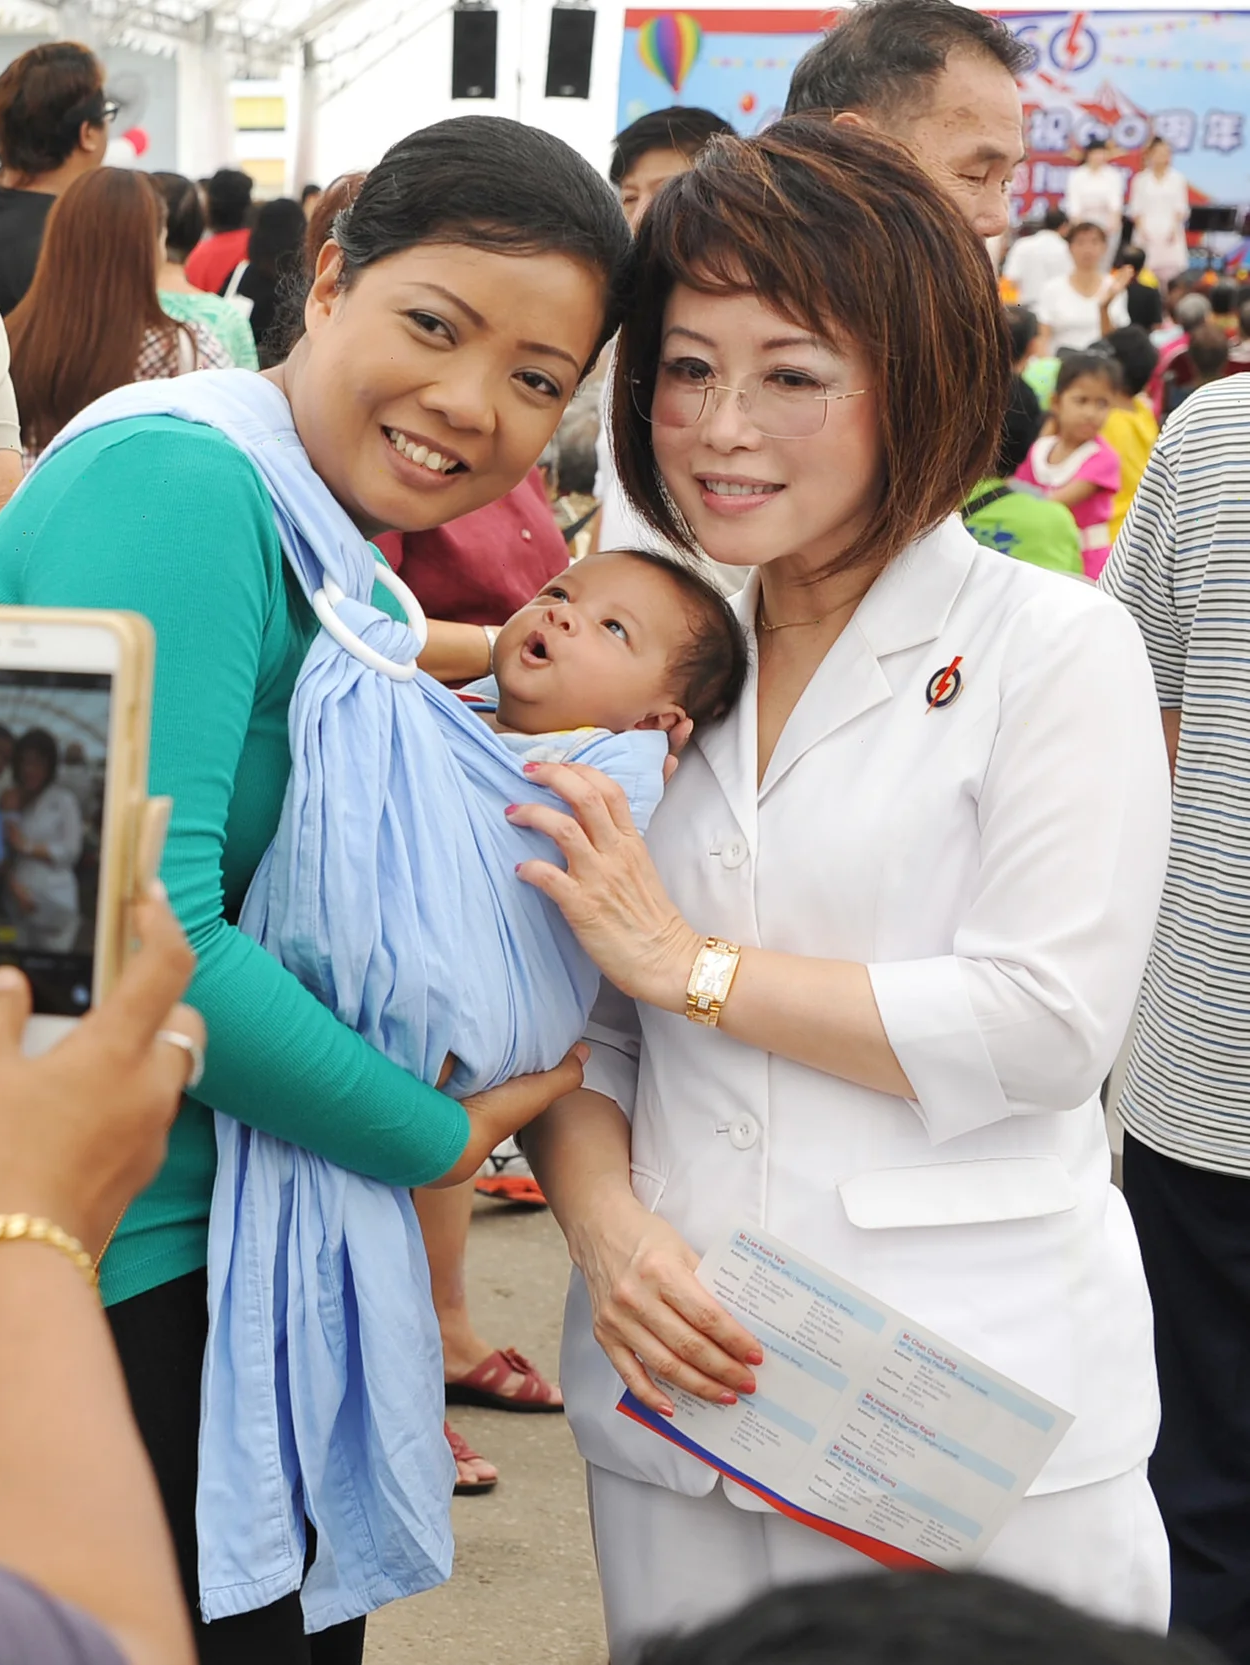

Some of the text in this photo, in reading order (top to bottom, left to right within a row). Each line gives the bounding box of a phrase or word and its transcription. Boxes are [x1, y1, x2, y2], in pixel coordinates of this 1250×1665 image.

[738, 1232, 747, 1241] Mr
[901, 1332, 958, 1370] Mr Chan Chun Sing
[832, 1444, 841, 1452] Mr
[854, 1457, 866, 1467] Tan
